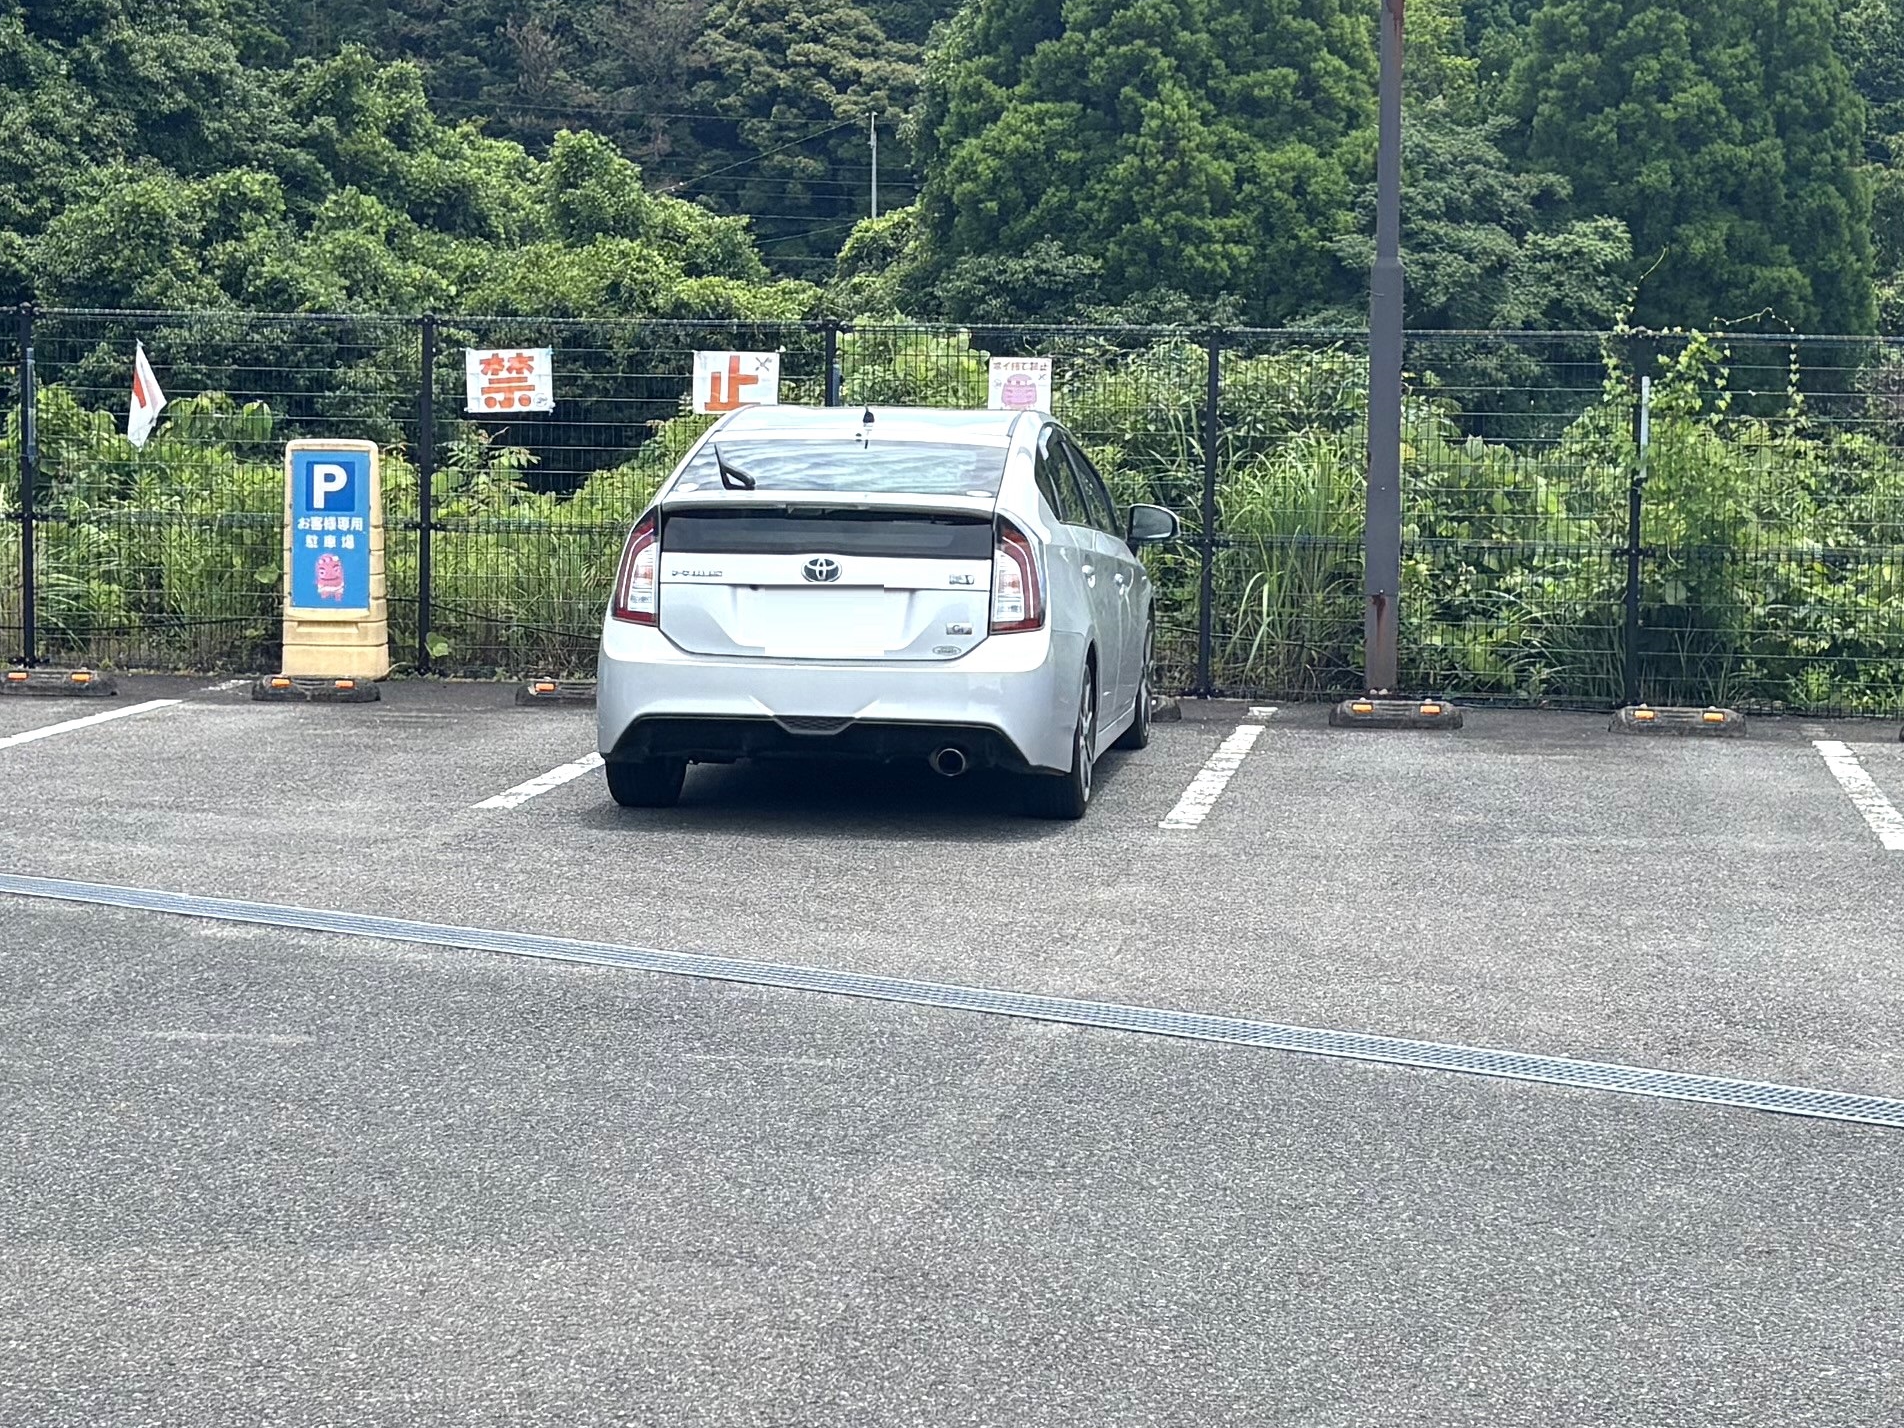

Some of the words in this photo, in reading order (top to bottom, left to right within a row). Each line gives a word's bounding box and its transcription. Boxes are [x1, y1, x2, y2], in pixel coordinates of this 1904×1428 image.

[479, 352, 536, 409] 禁
[704, 355, 761, 411] 止
[312, 463, 348, 509] P
[297, 516, 364, 532] お客様専用
[305, 533, 356, 550] 駐車場
